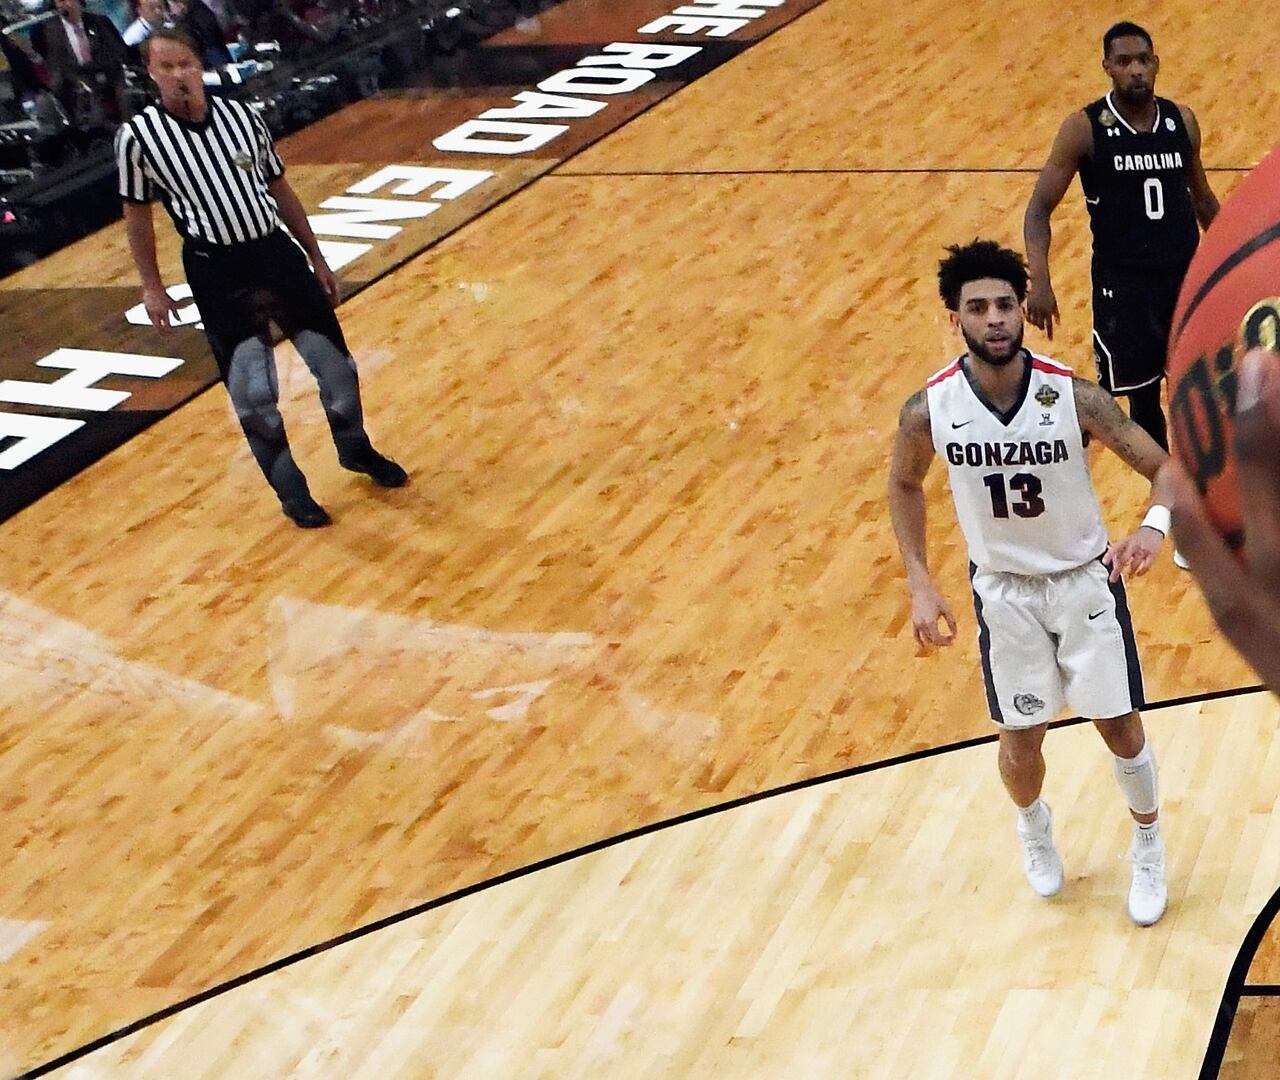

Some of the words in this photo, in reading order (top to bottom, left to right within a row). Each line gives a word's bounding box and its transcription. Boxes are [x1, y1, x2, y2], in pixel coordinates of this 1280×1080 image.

[432, 42, 703, 155] ROAD
[1113, 152, 1184, 171] CAROLINA
[1143, 177, 1165, 220] 0
[945, 439, 1070, 468] GONZAGA
[983, 472, 1046, 519] 13
